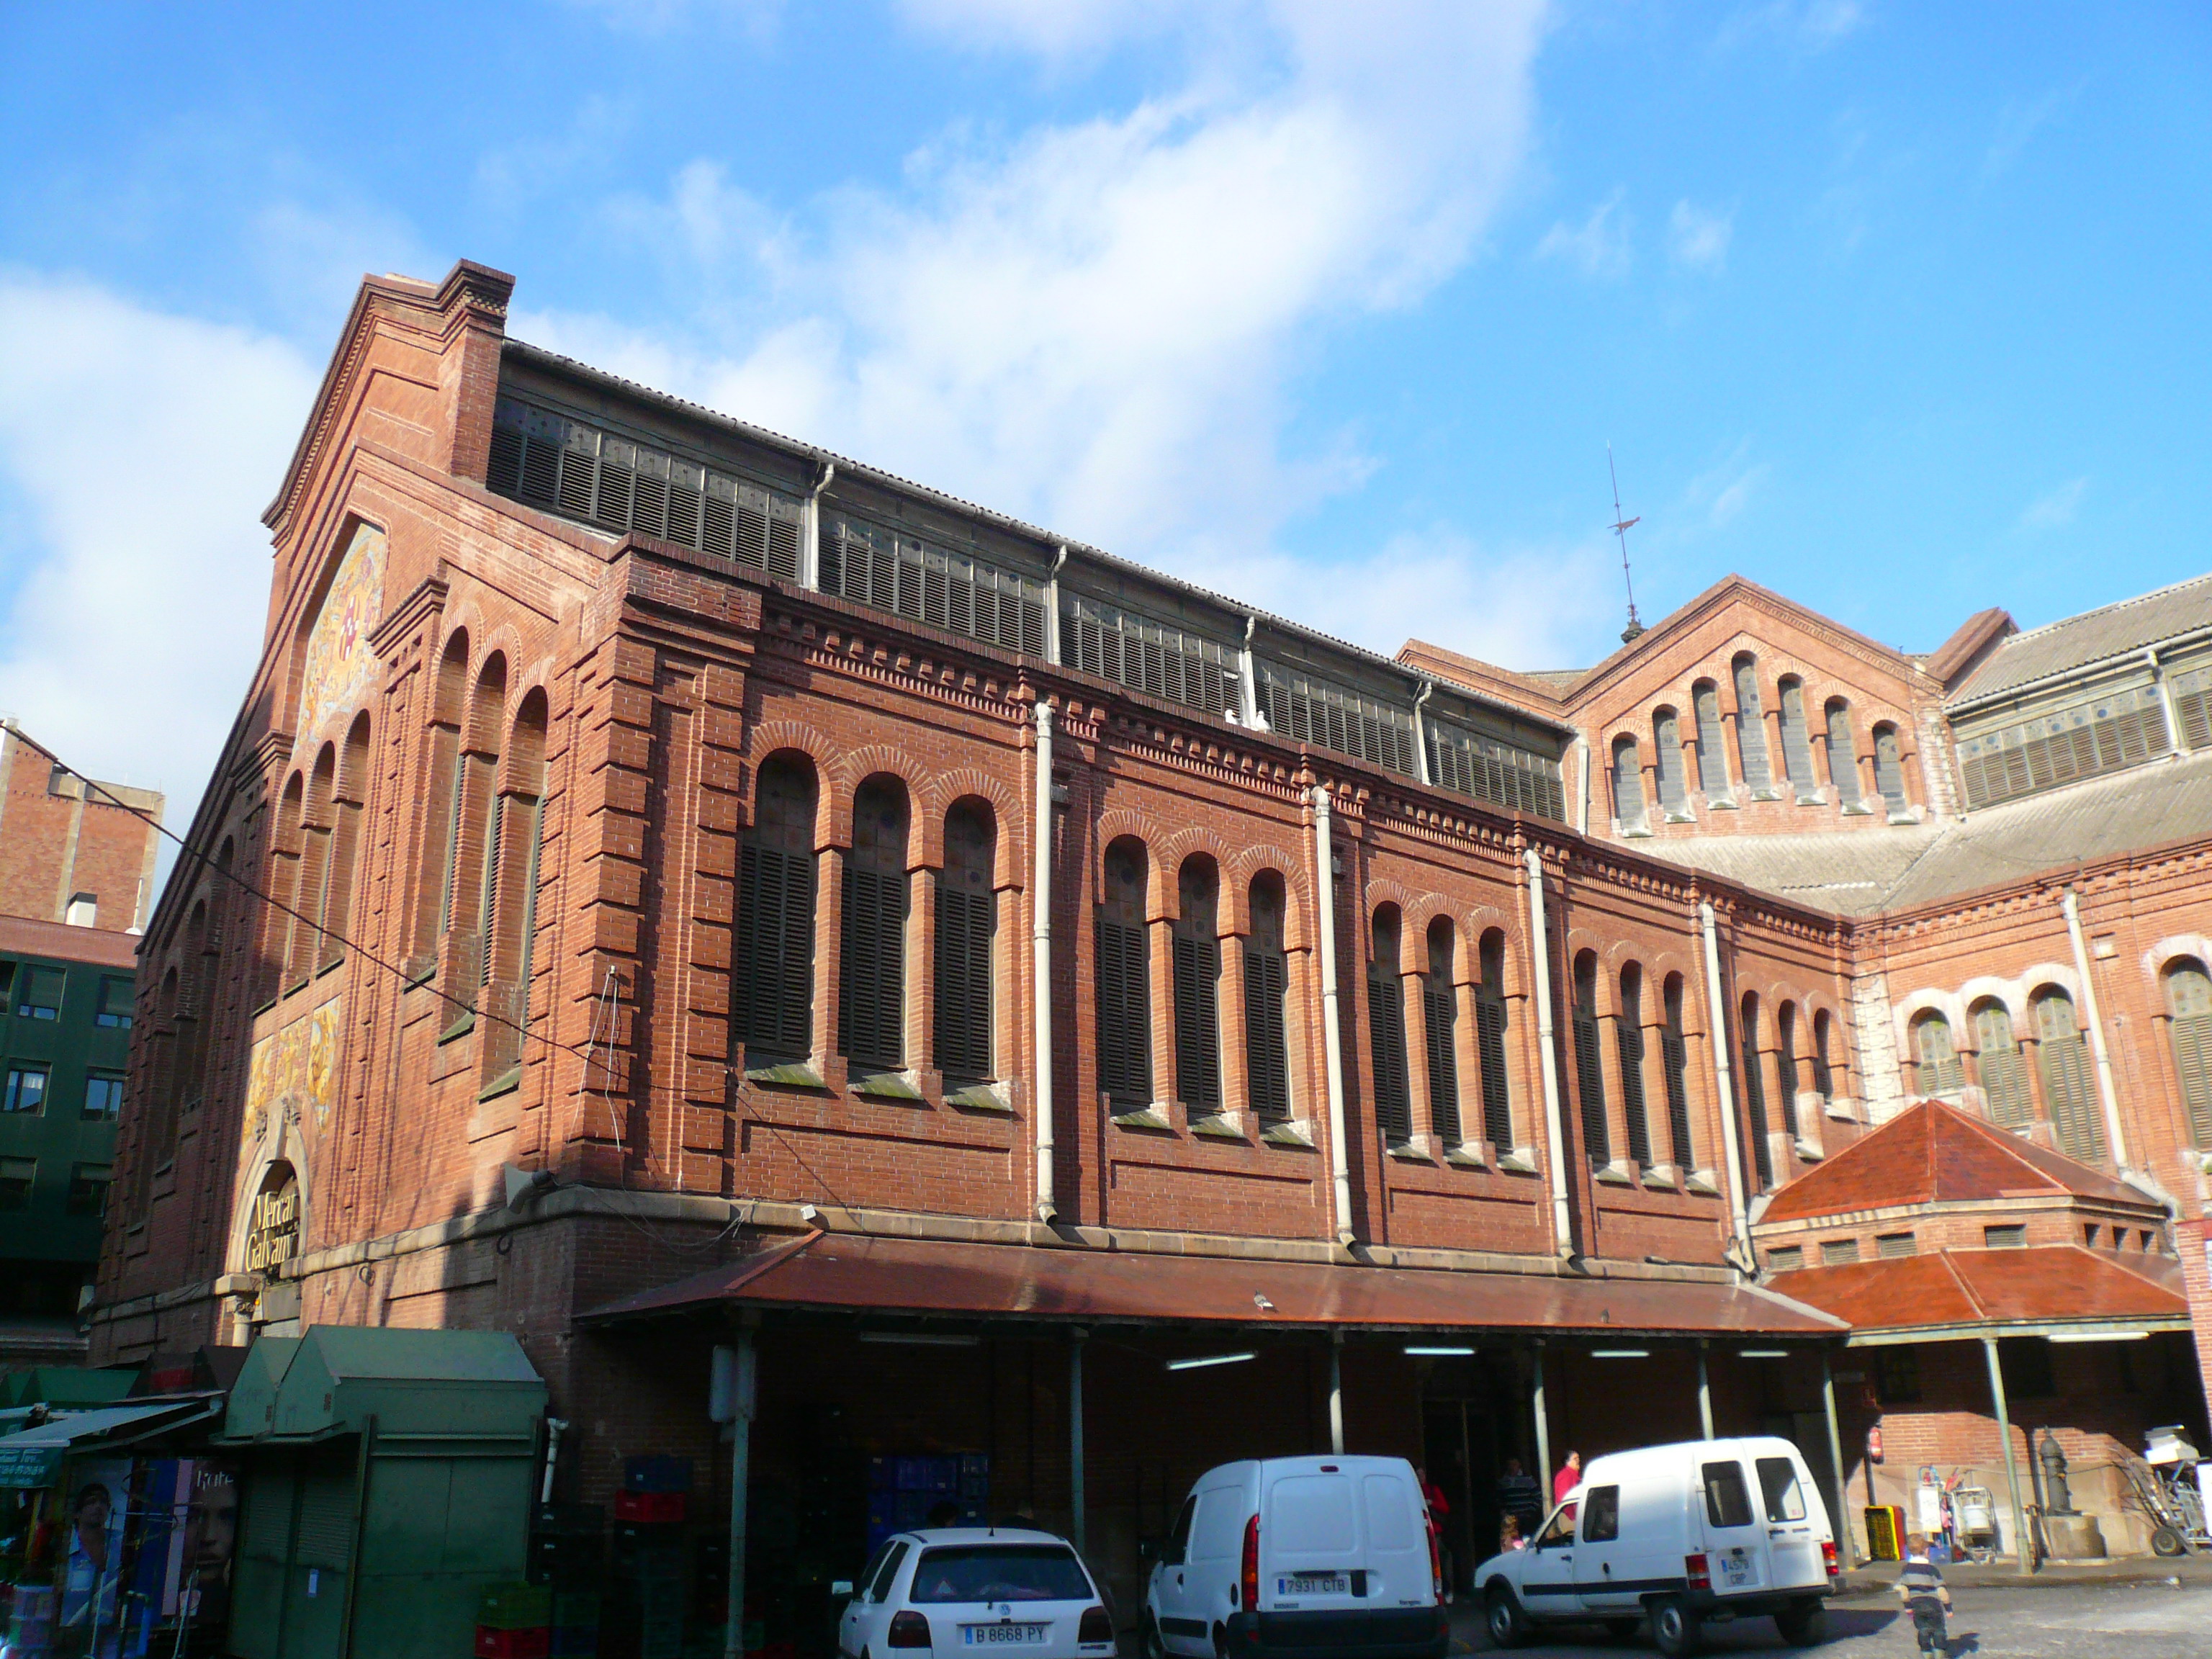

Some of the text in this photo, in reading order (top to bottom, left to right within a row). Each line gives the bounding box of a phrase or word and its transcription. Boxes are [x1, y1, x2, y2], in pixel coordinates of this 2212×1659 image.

[253, 1192, 297, 1232] Mercat
[1287, 1578, 1345, 1593] 7931 CTB
[976, 1626, 1045, 1643] B 8668 PY
